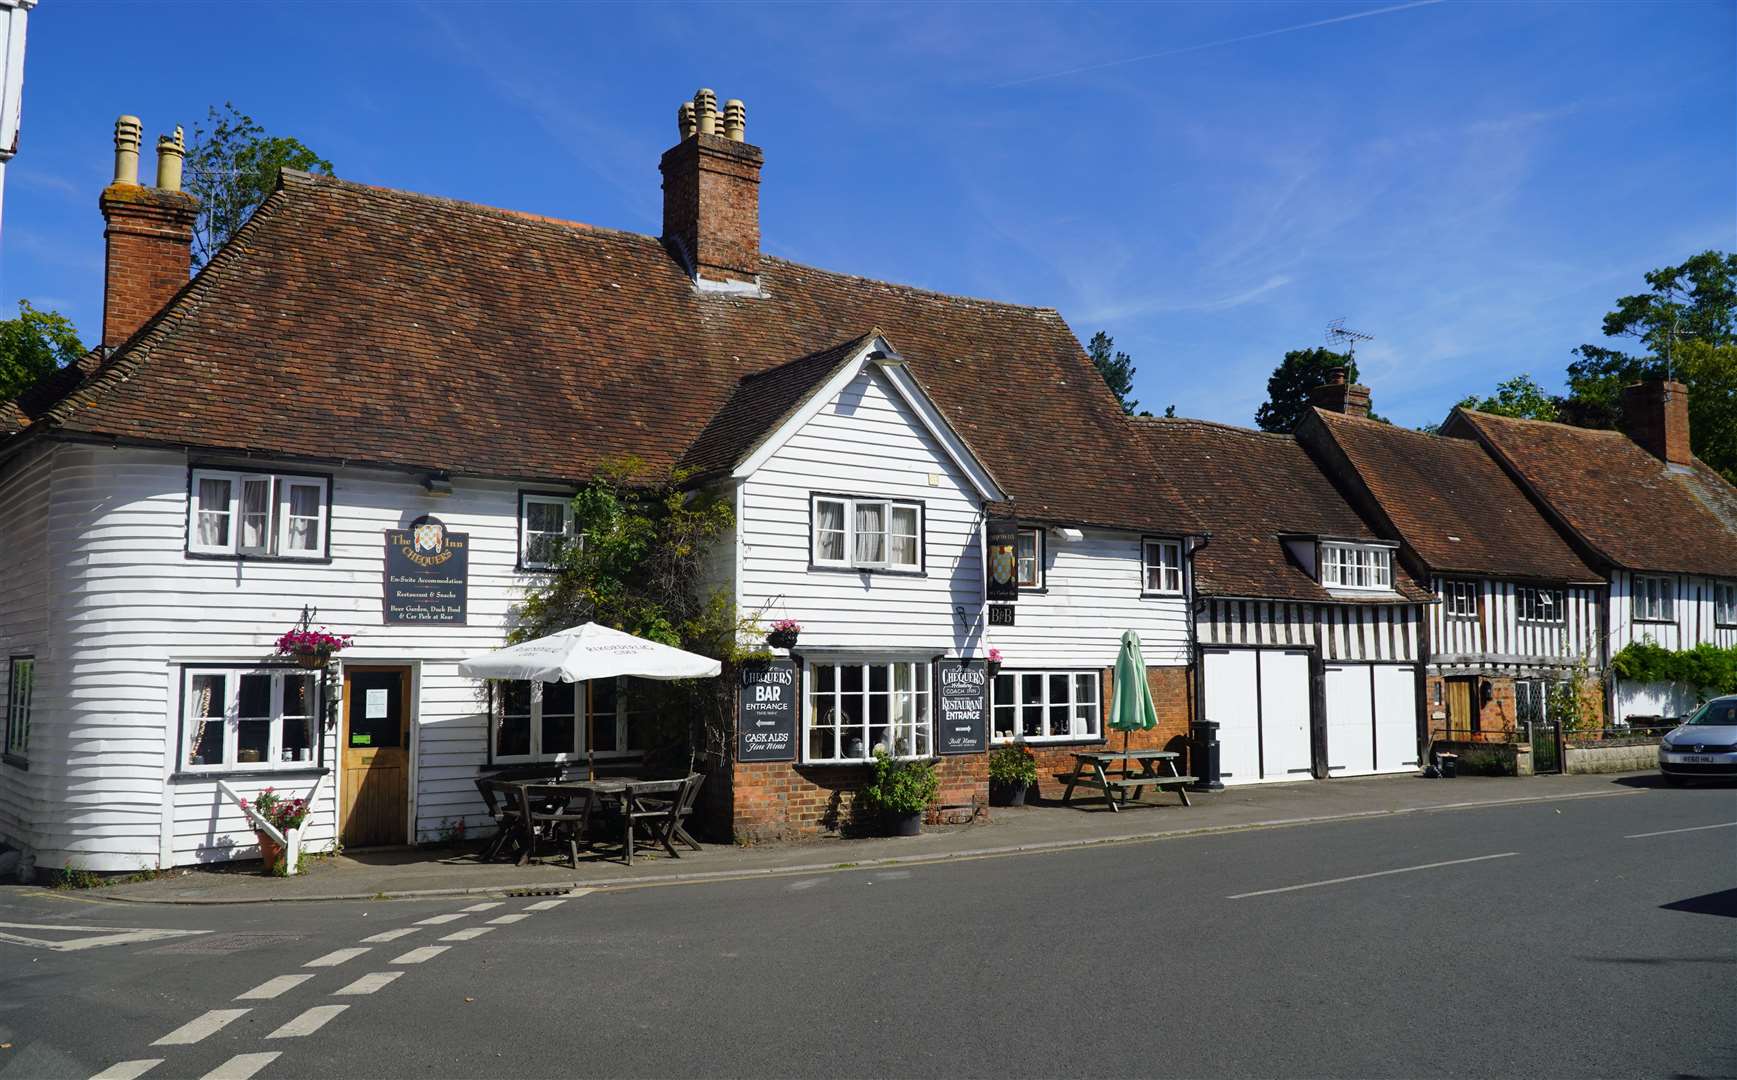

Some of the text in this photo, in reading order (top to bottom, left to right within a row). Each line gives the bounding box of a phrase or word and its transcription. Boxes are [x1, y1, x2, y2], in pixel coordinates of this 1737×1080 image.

[392, 534, 411, 545] The
[445, 538, 463, 548] Inn
[402, 546, 453, 567] CHEQUERS
[418, 577, 463, 585] Accommodation
[396, 590, 428, 598] Restaurant
[436, 591, 456, 599] Snacks
[390, 604, 405, 612] Beer
[743, 669, 793, 686] CHEQUERS
[942, 668, 985, 686] CHEQUERS
[755, 686, 781, 702] BAR
[746, 703, 788, 711] ENTRANCE
[942, 696, 983, 711] RESTAURANT
[946, 711, 981, 720] ENTRANCE
[745, 732, 789, 743] CASK ALES
